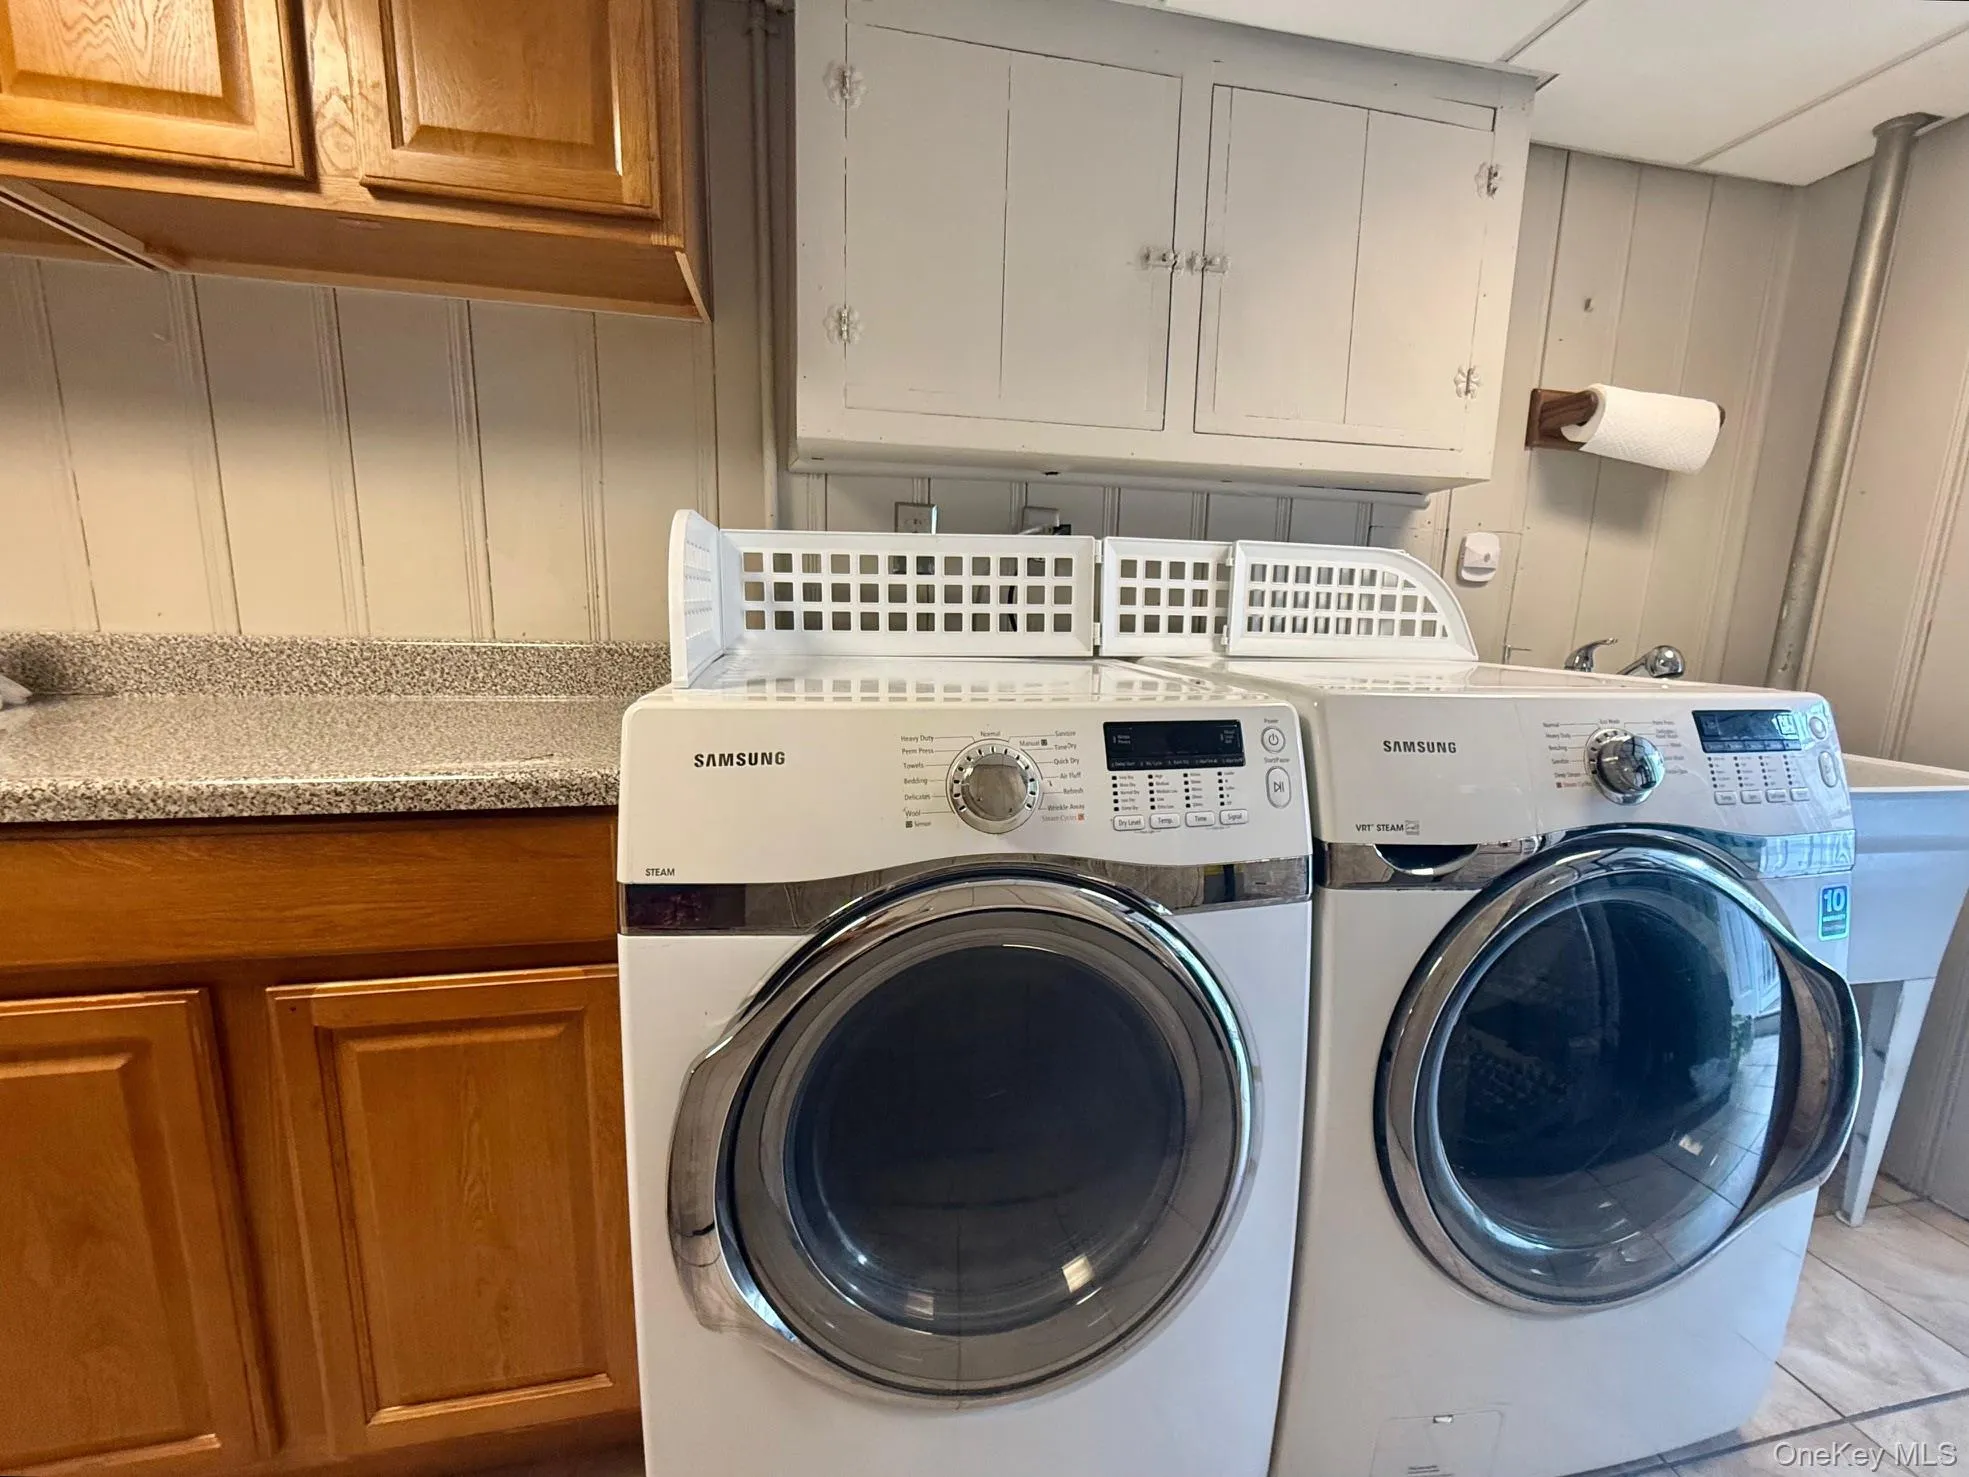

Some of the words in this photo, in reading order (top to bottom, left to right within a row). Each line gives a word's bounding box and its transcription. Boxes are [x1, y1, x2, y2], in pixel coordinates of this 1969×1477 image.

[1383, 740, 1456, 753] SAMSUNG
[694, 751, 786, 767] SAMSUNG
[645, 868, 675, 876] STEAM
[1824, 889, 1845, 912] 10
